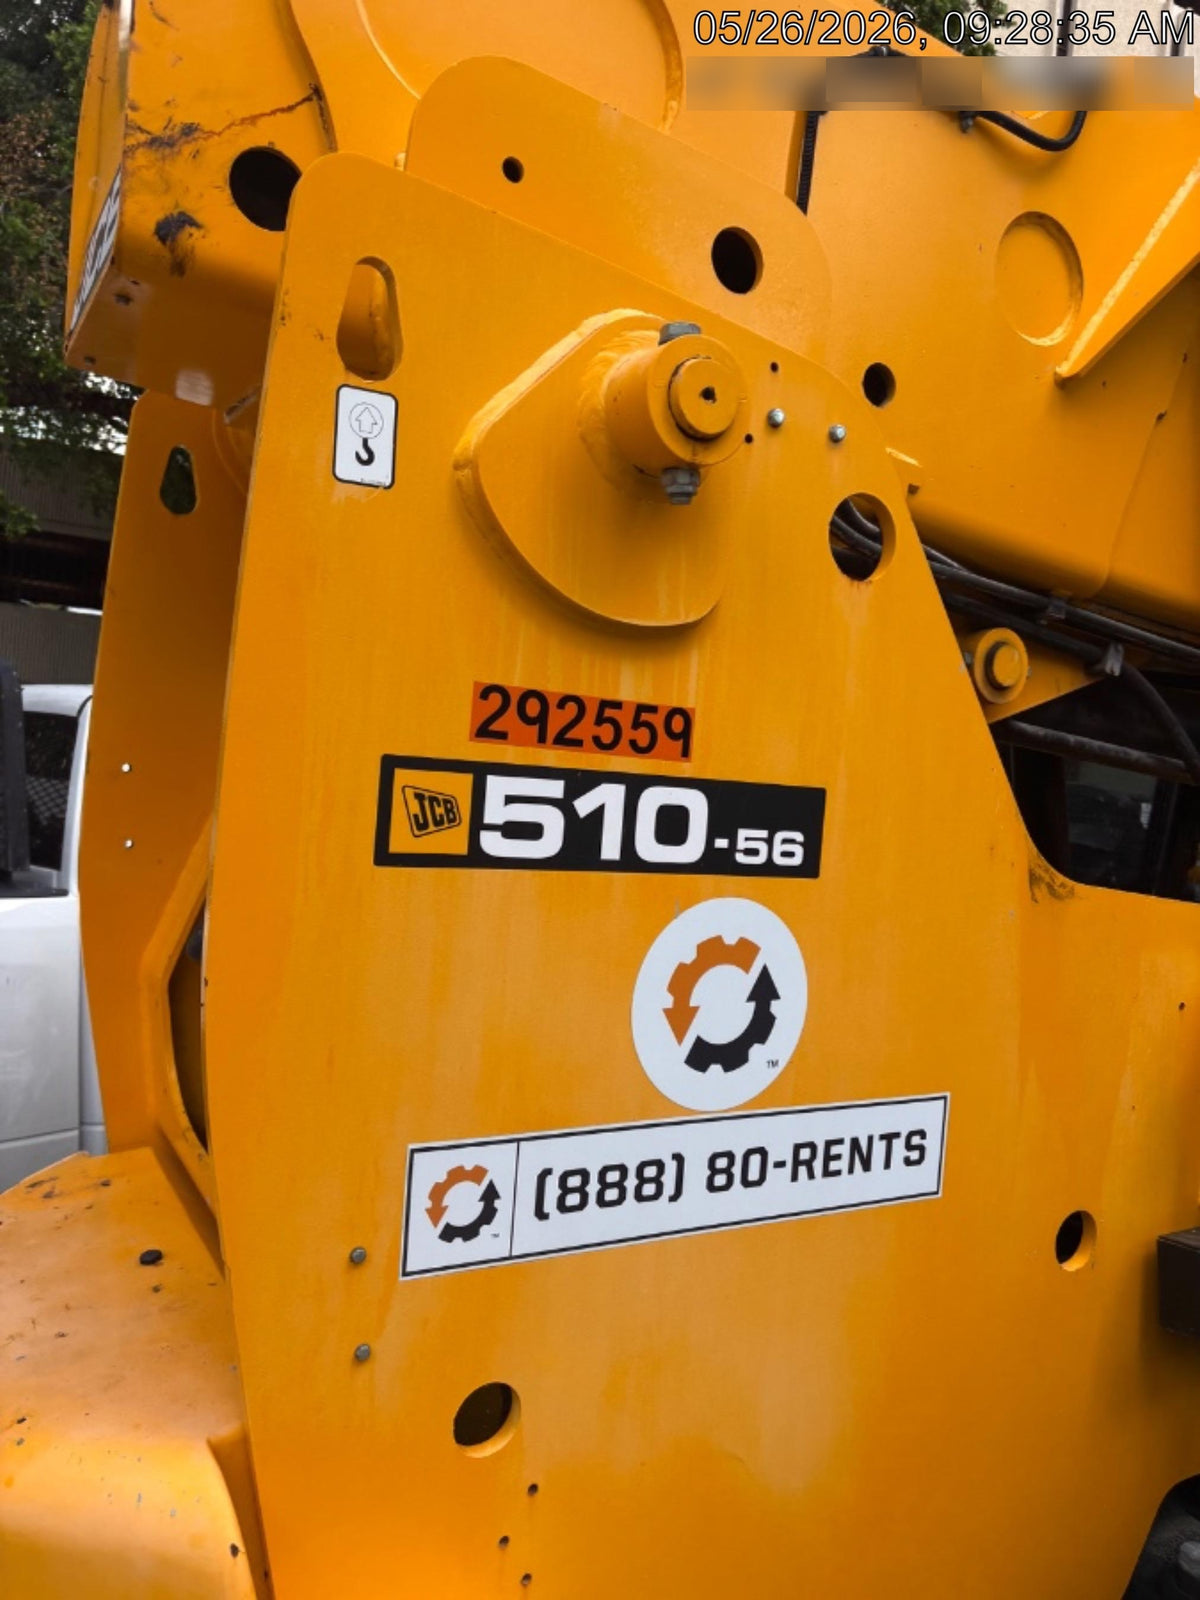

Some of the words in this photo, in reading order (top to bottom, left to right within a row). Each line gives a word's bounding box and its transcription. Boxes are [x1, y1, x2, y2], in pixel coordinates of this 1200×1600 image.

[474, 684, 693, 758] 292559
[412, 792, 458, 832] JCB
[533, 1152, 686, 1221] (888)
[705, 1128, 928, 1194] 80-RENTS
